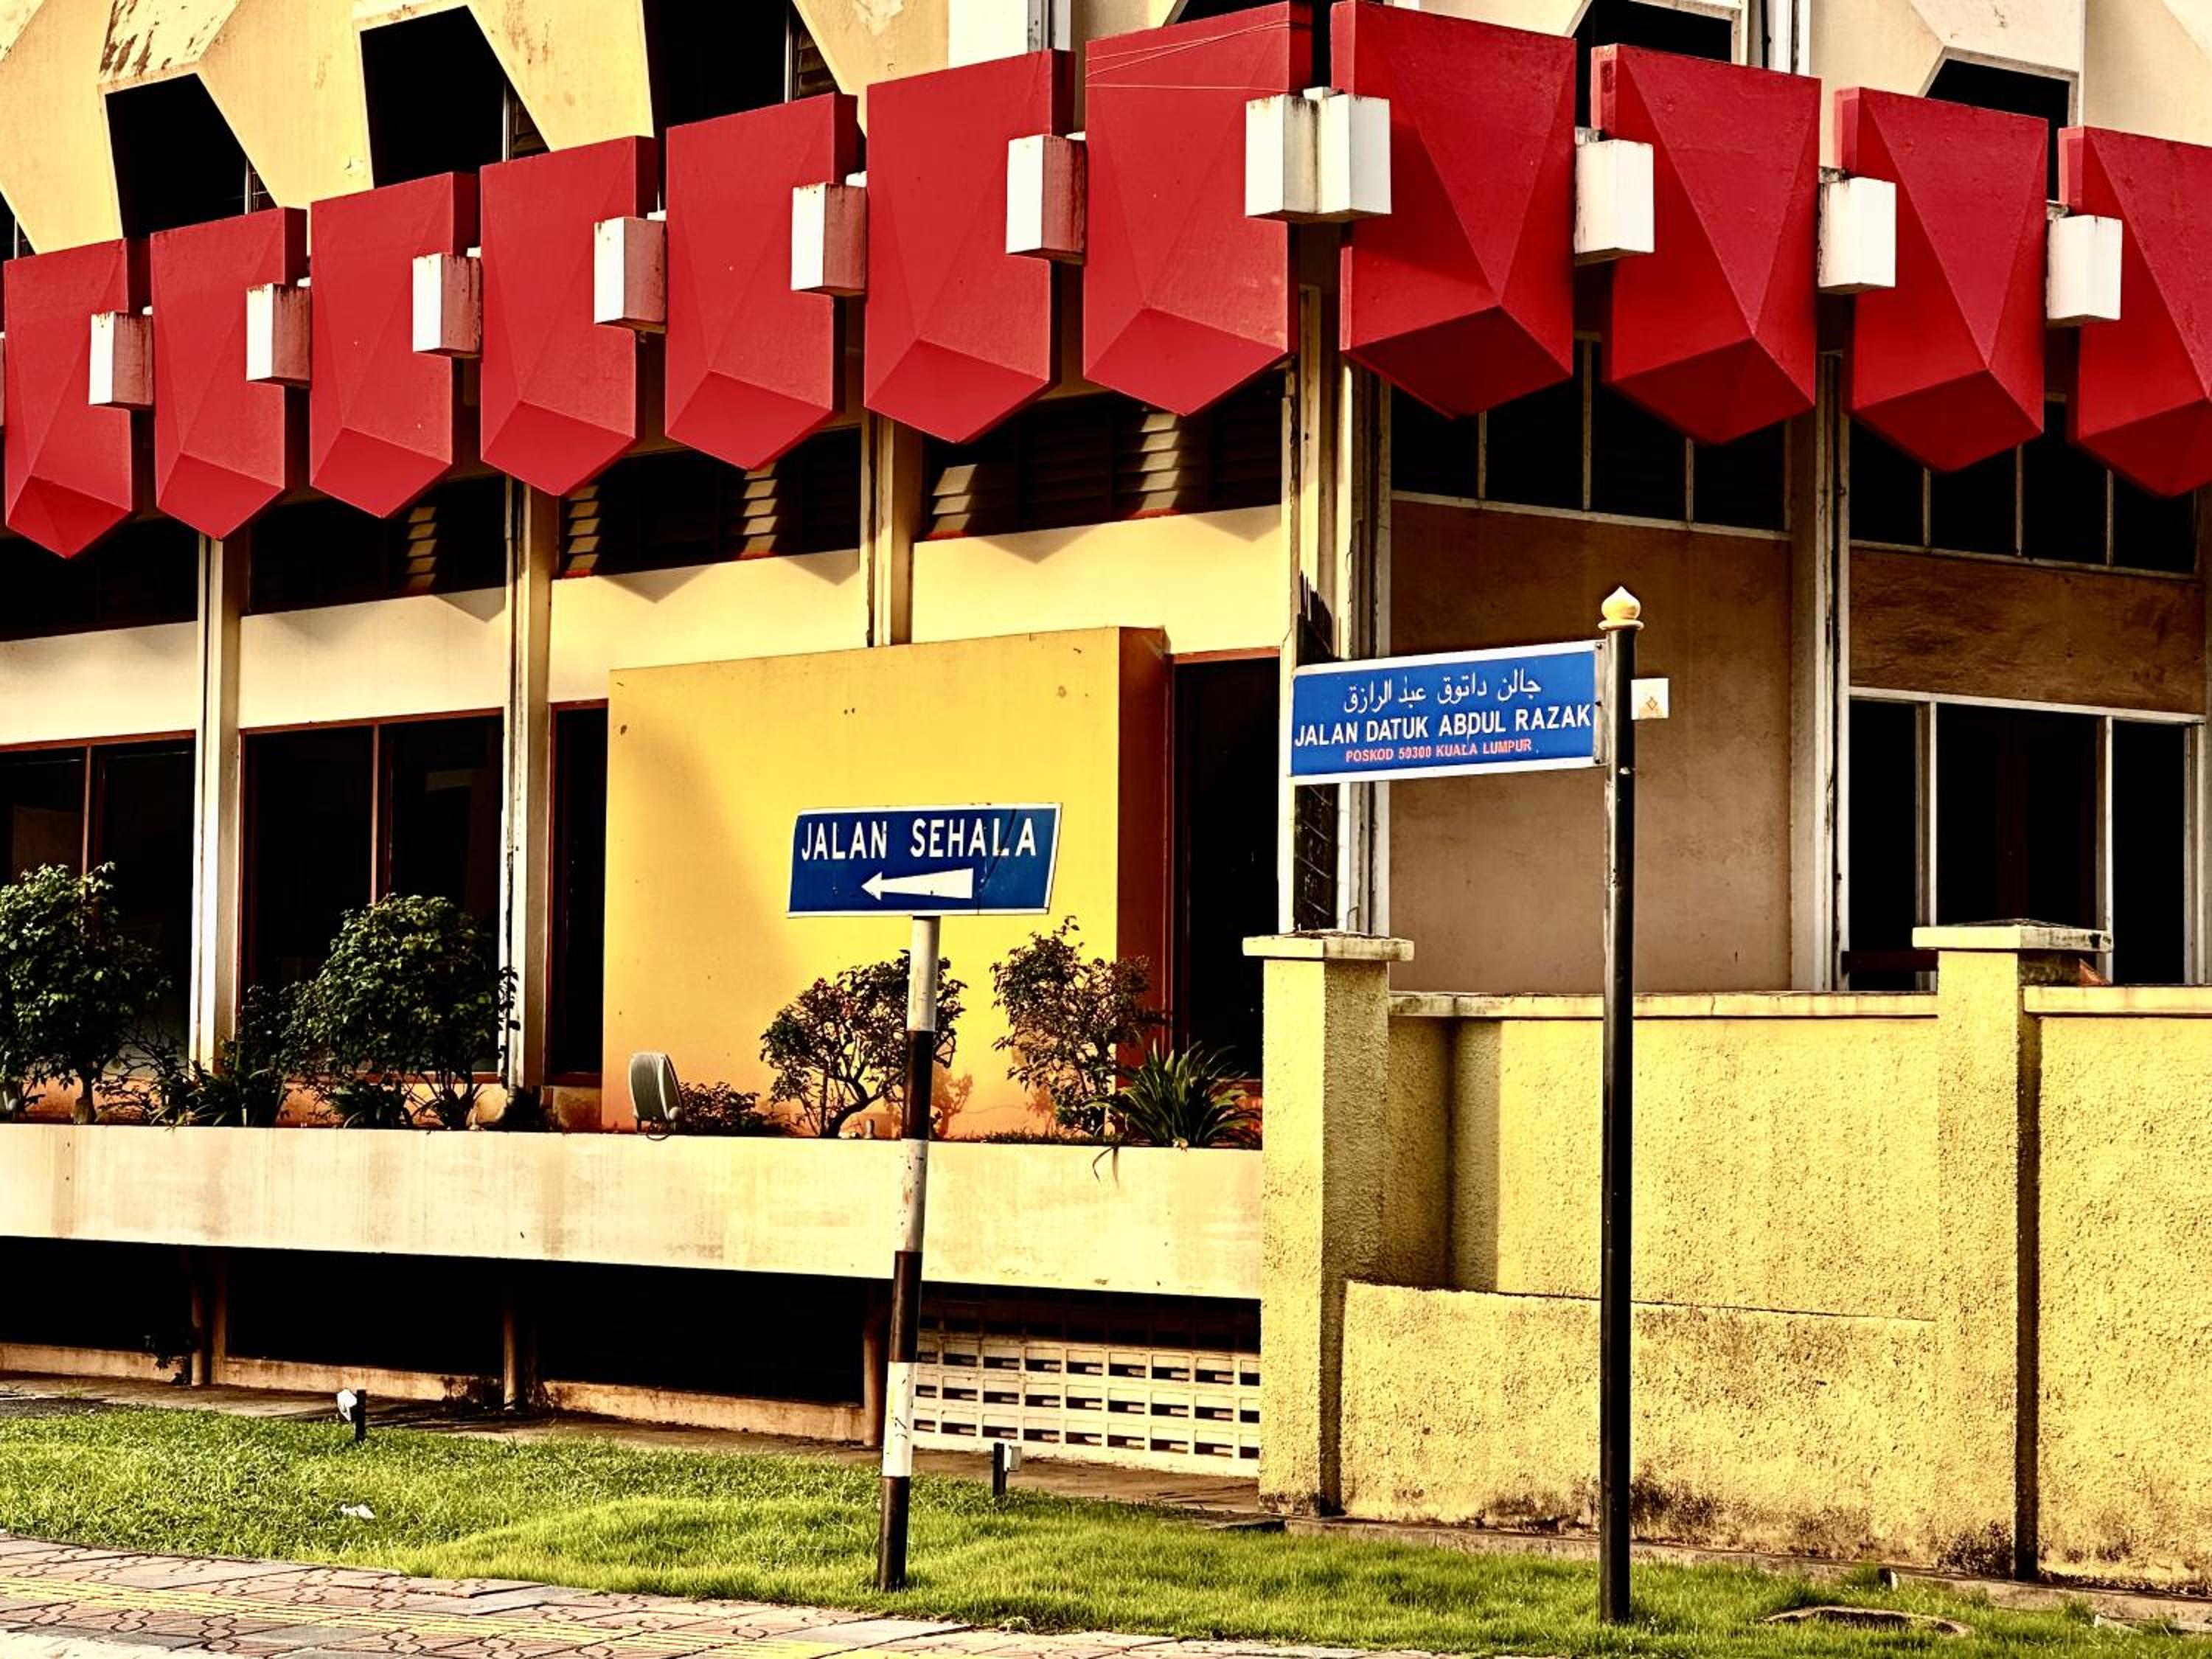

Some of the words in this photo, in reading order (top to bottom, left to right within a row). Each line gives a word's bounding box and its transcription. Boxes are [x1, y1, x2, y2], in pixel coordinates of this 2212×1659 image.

[1343, 678, 1392, 714] الرازق
[1437, 672, 1487, 704] داتوق
[1498, 668, 1542, 701] جالن
[1295, 721, 1358, 747] JALAN
[1366, 716, 1428, 742] DATUK
[1439, 710, 1506, 737] ABDUL
[1515, 703, 1591, 732] RAZAK
[1346, 748, 1394, 762] POSKOD
[1399, 745, 1432, 759] 50300
[1436, 742, 1478, 757] KUALA
[1483, 738, 1532, 755] LUMPUR
[801, 821, 887, 860] JALAN
[910, 818, 1037, 858] SEHALA
